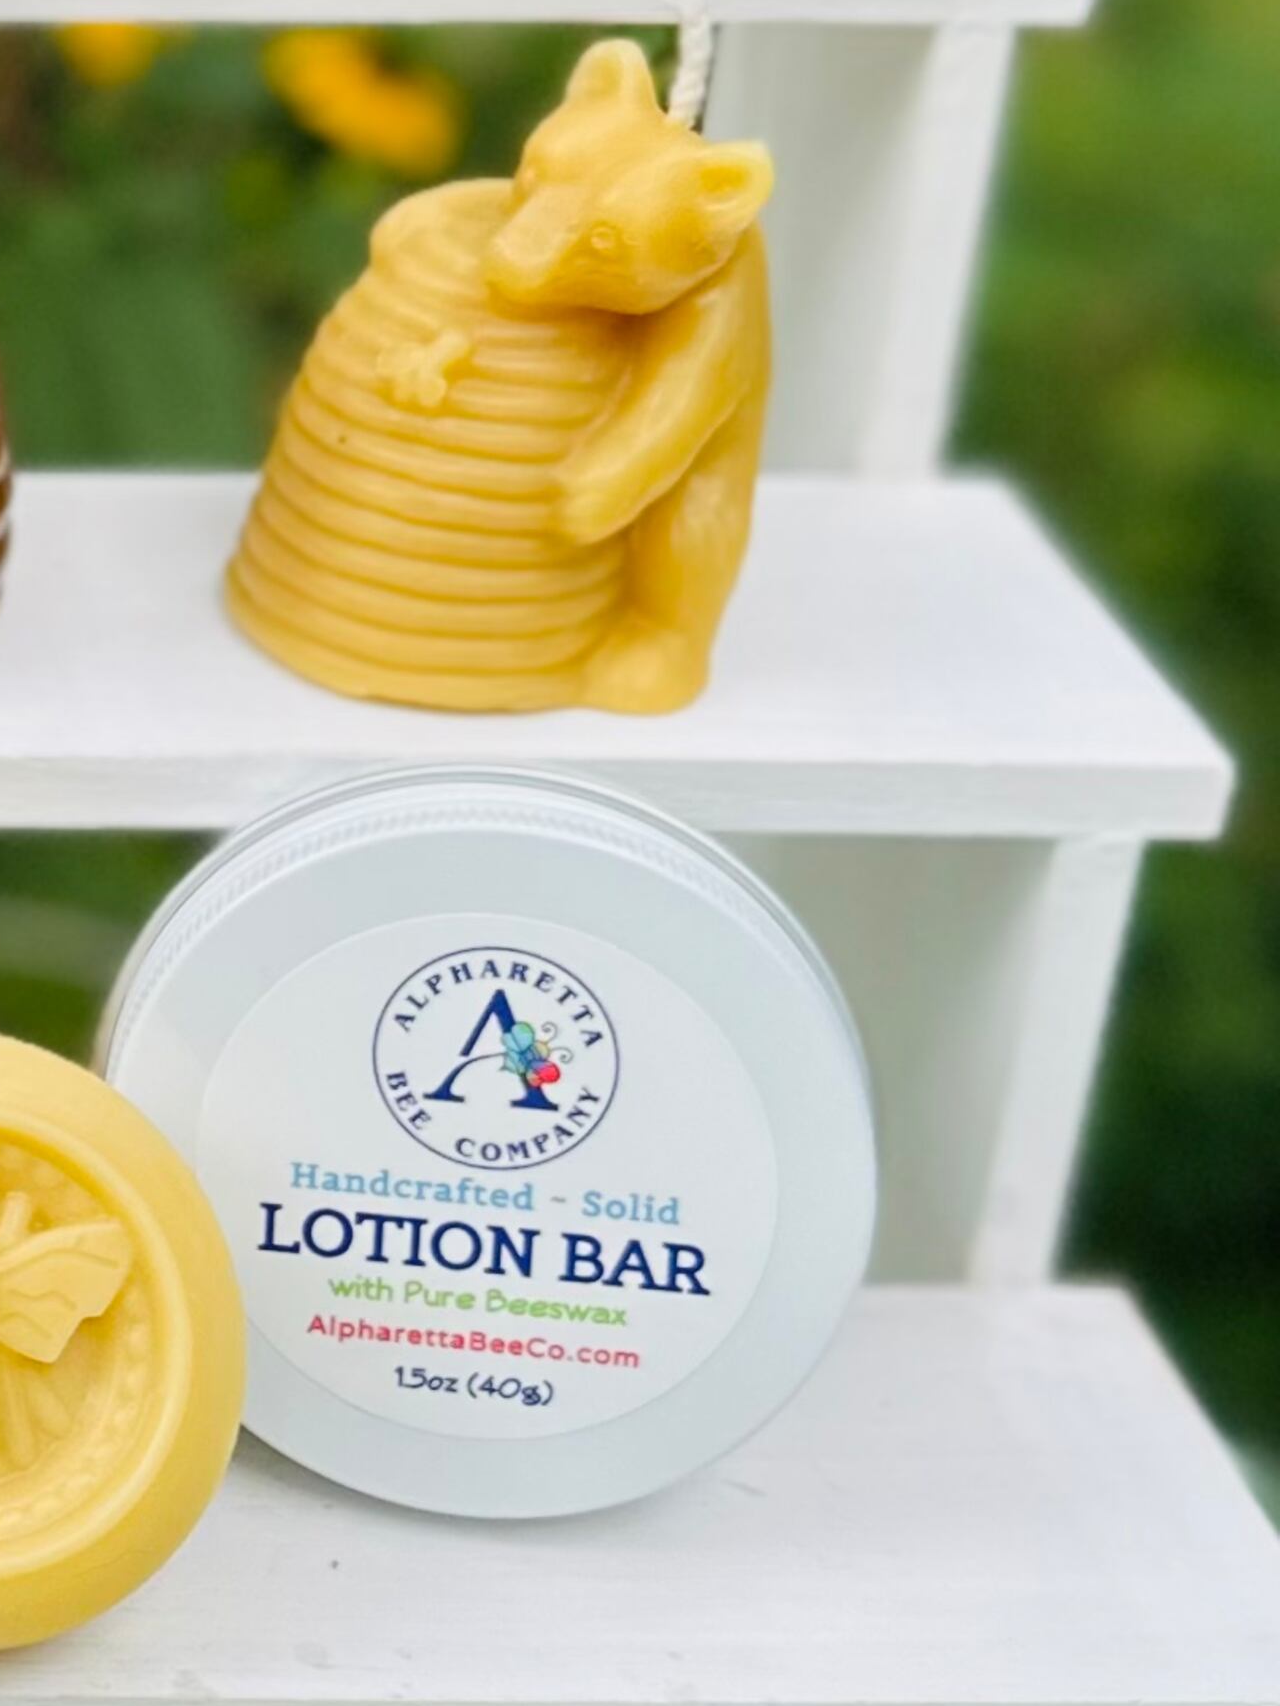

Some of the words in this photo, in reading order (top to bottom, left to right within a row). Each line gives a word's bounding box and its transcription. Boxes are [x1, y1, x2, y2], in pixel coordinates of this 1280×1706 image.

[394, 959, 603, 1048] ALPHARETTA
[387, 1071, 432, 1130] BEE
[455, 1087, 600, 1161] COMPANY
[290, 1161, 536, 1211] Handcrafted
[582, 1191, 680, 1225] Solid
[258, 1202, 540, 1278] LOTION
[558, 1233, 711, 1296] BAR
[327, 1275, 394, 1302] with
[404, 1280, 475, 1310] Pure
[485, 1289, 627, 1326] Beeswax
[307, 1314, 640, 1368] AlpharettaBeeCo.com
[467, 1372, 553, 1406] (40g)
